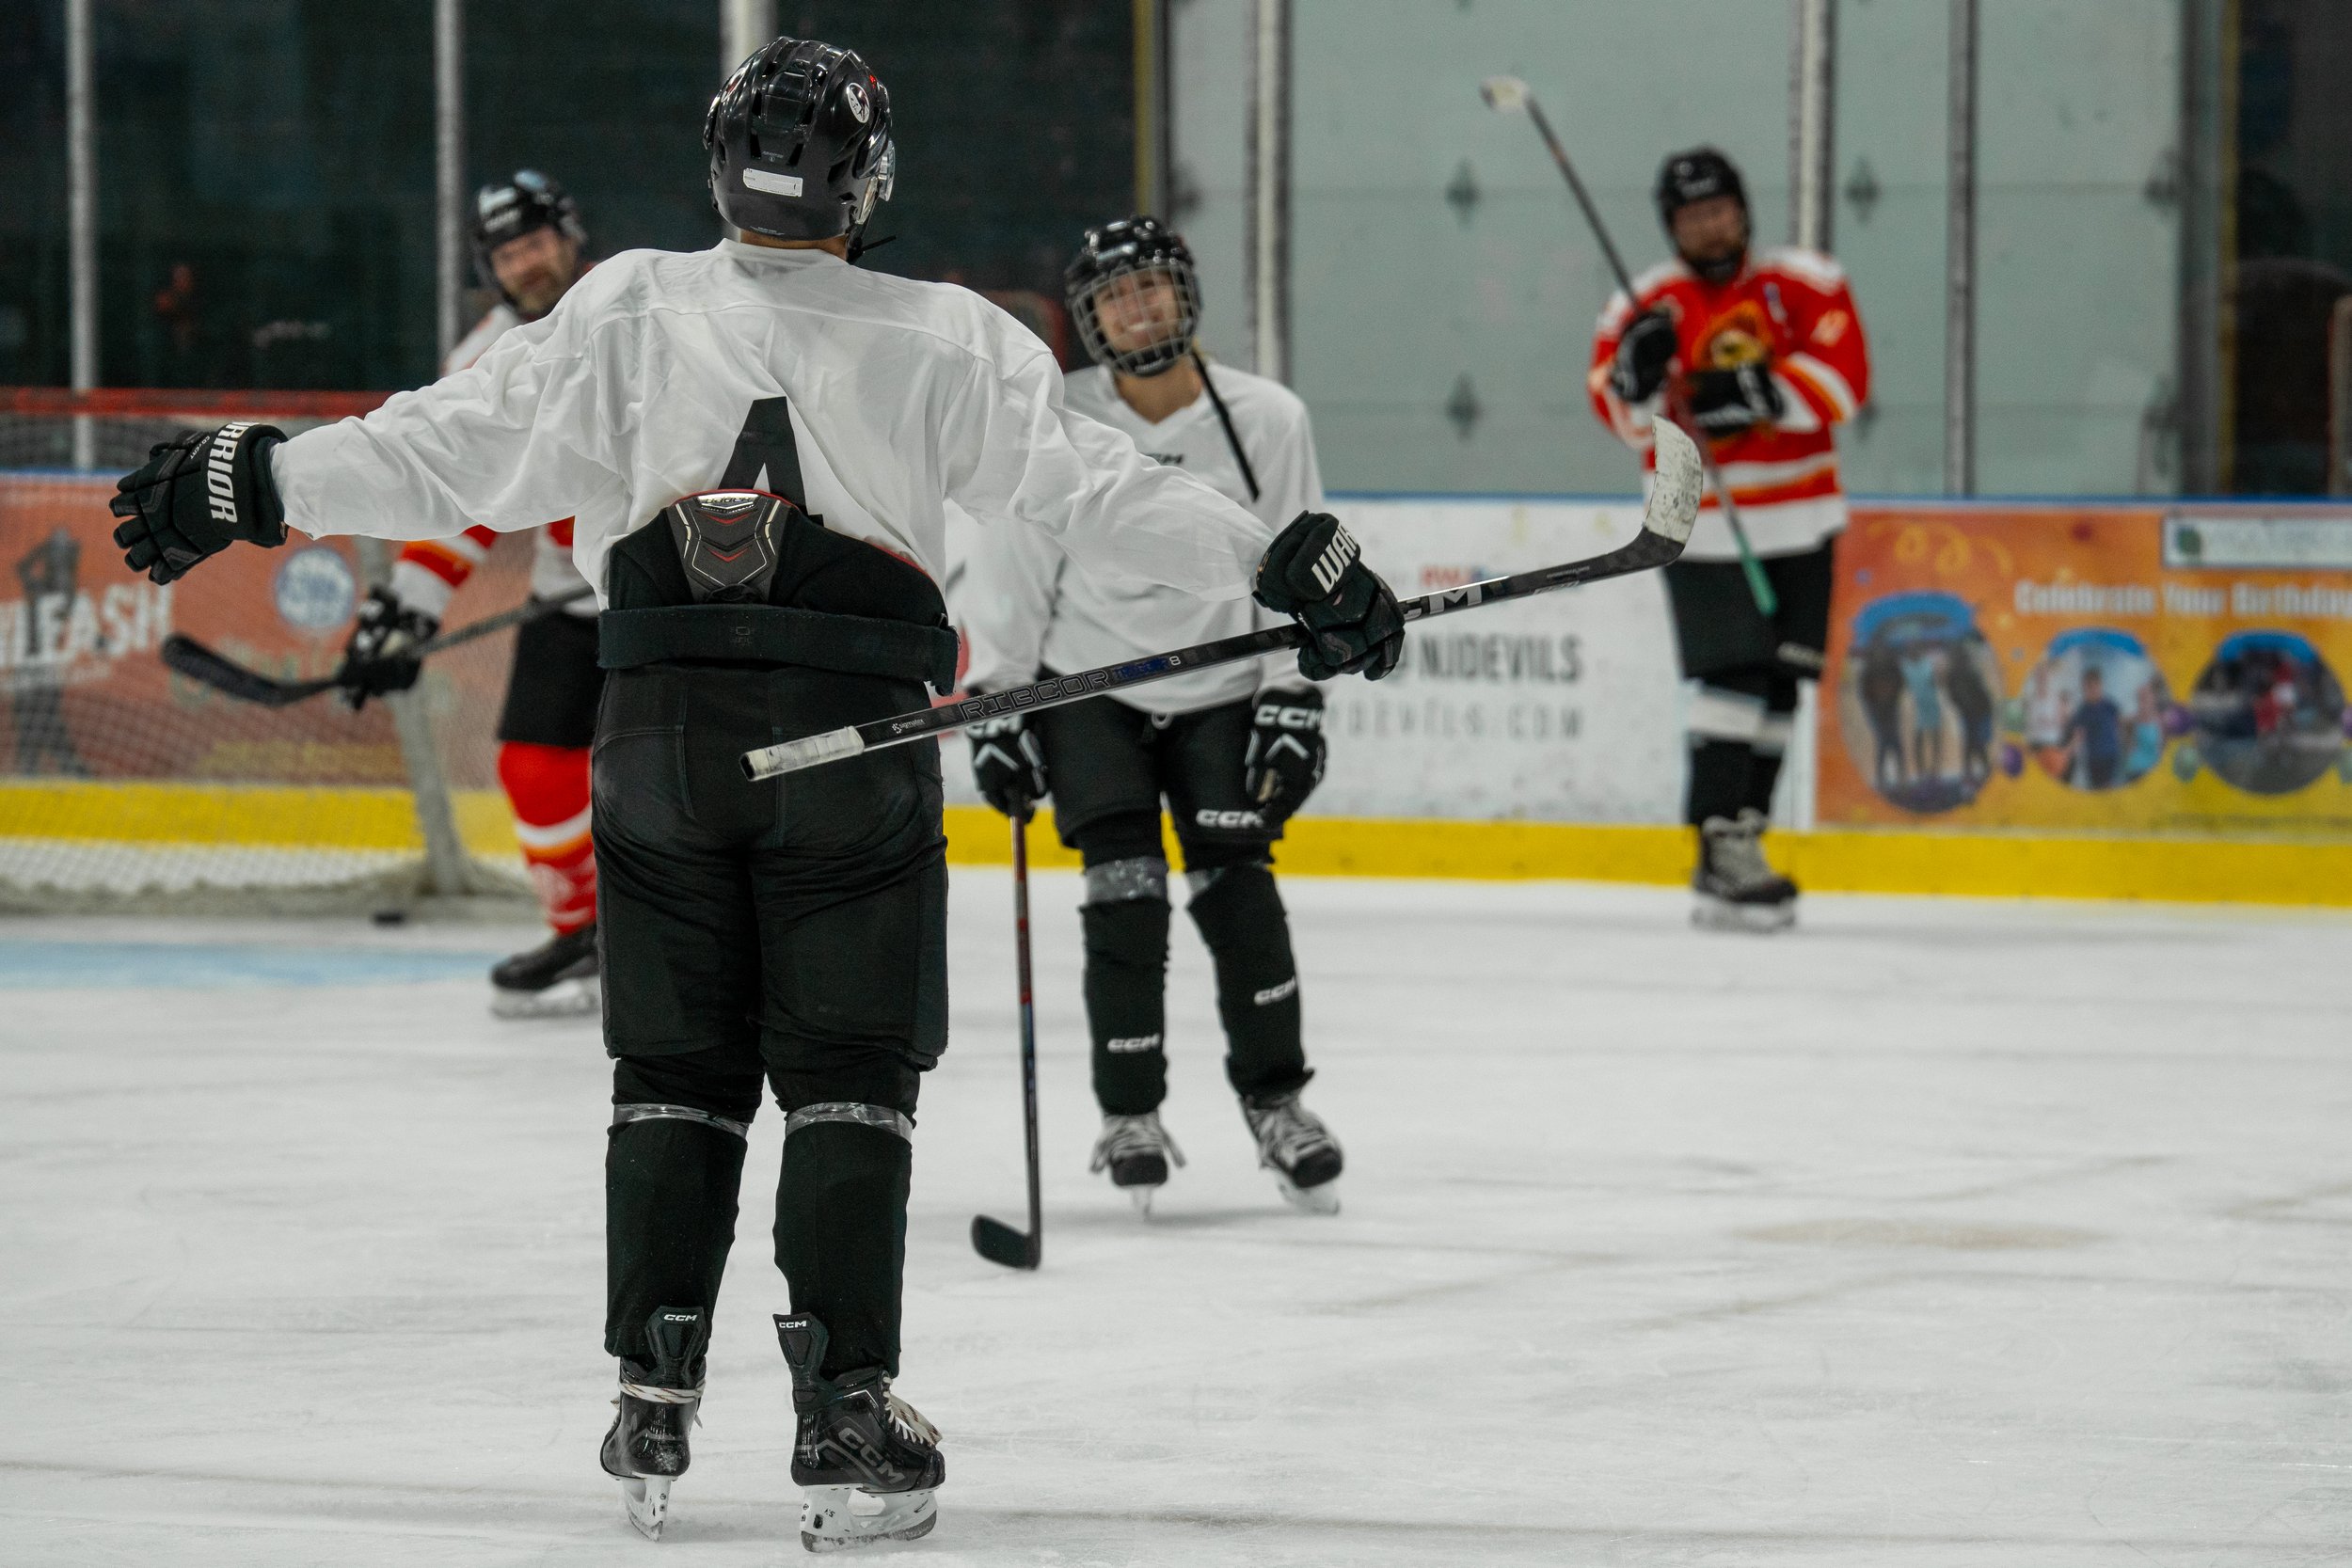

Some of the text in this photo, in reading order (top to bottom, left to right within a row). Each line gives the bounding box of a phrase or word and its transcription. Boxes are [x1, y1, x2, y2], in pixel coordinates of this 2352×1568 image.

[958, 669, 1110, 721] RIBCOR
[1169, 656, 1181, 666] 8
[1107, 1033, 1161, 1053] CCM
[663, 1313, 698, 1323] CCM
[778, 1320, 807, 1329] CCM
[838, 1426, 905, 1484] CCM
